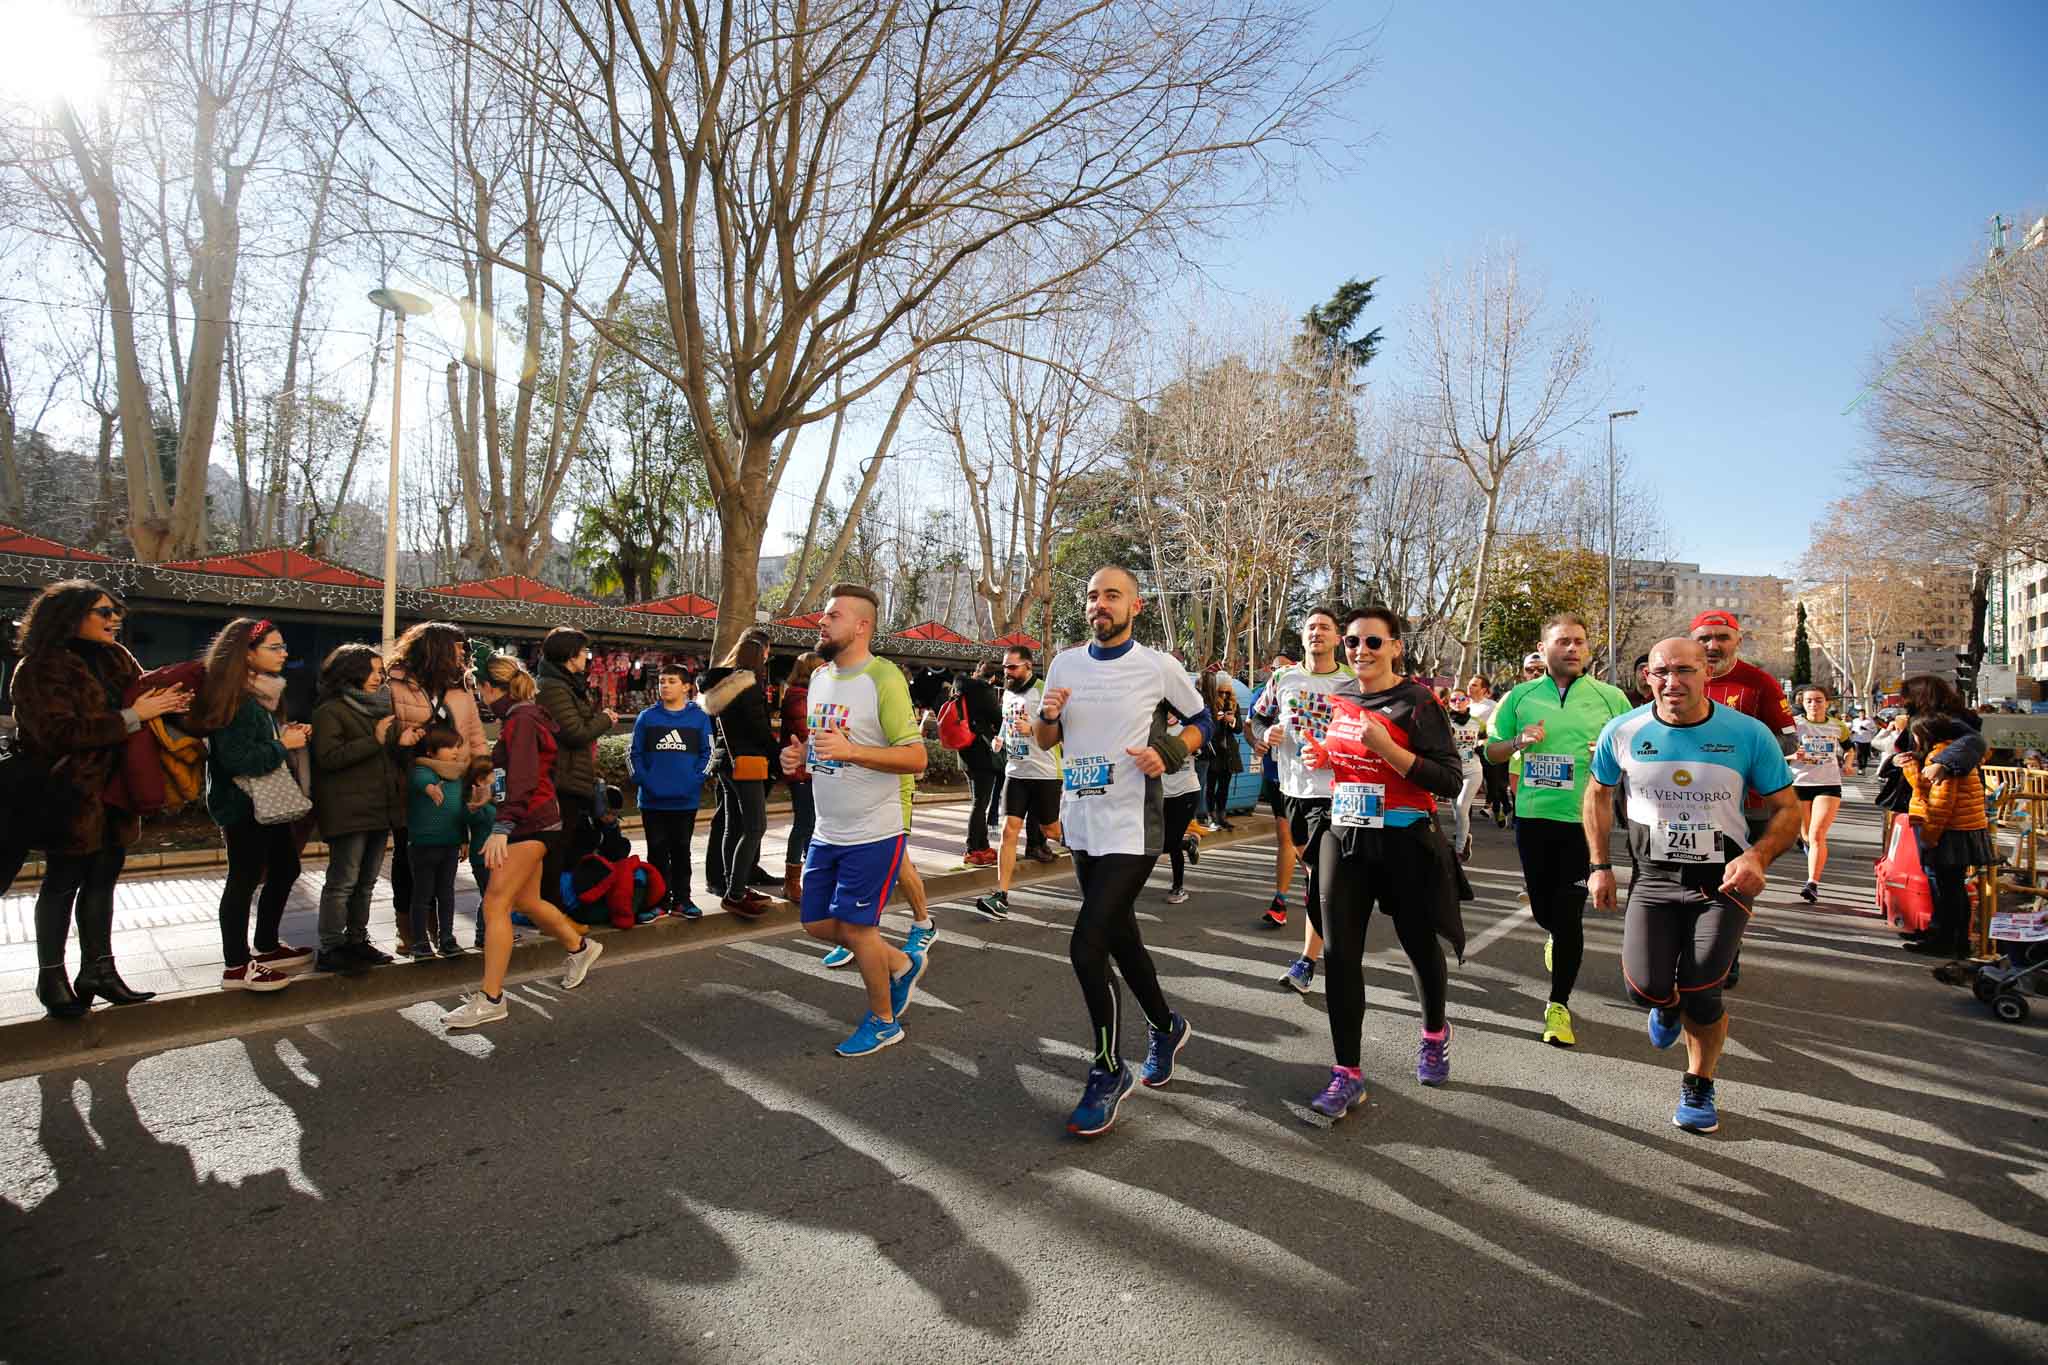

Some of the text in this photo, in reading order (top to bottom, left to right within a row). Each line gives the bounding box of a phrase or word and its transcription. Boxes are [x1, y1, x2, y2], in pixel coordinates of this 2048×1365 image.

[656, 742, 687, 751] adidas
[1072, 765, 1101, 785] 2132
[1531, 762, 1561, 778] 3606
[1654, 789, 1732, 802] VENTORRO
[1668, 823, 1715, 831] SETEL
[1668, 832, 1697, 849] 241
